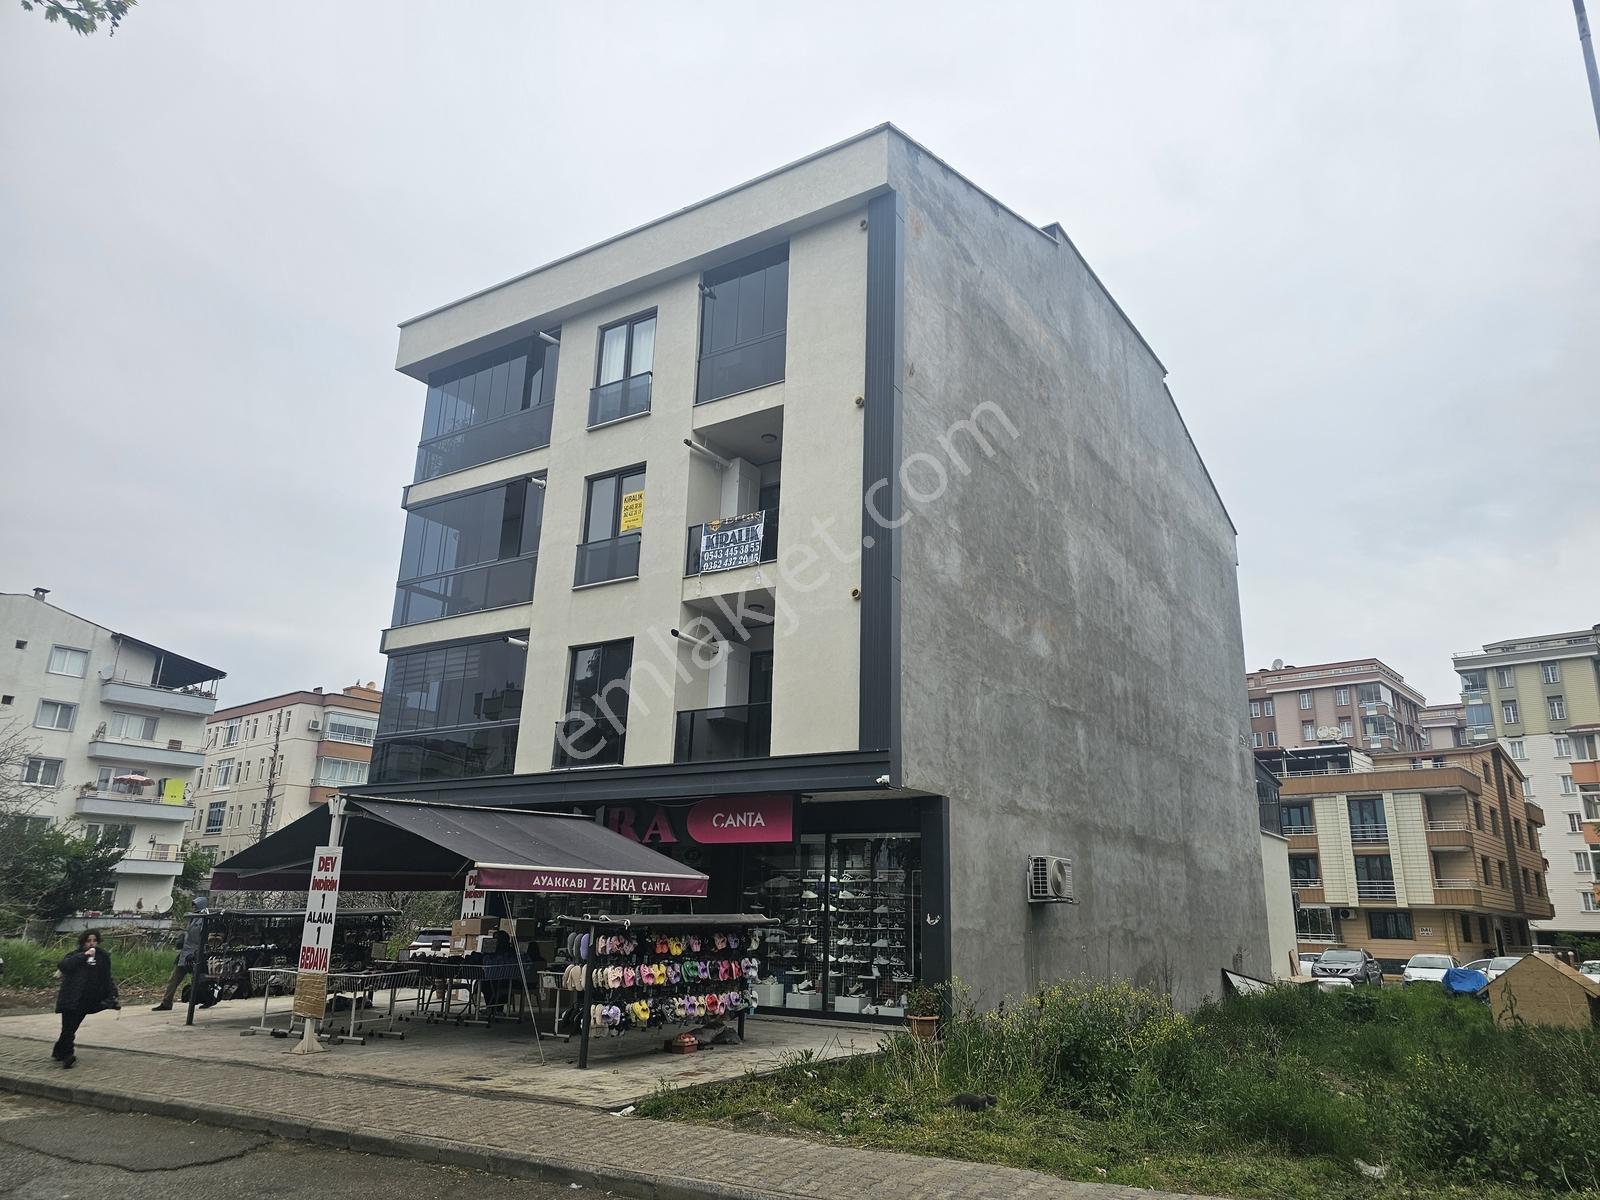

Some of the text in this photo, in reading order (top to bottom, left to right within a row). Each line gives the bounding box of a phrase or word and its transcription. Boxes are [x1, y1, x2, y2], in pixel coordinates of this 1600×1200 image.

[704, 542, 760, 561] 0543 445 38 55
[723, 556, 738, 567] 437
[318, 856, 337, 873] DEV
[312, 876, 338, 891] İNDİRİM
[532, 875, 671, 893] AYAKKABI ZEHRA ÇANTA
[321, 893, 326, 910] 1
[472, 899, 476, 911] 1
[306, 911, 333, 925] ALANA
[316, 926, 321, 945] 1
[300, 946, 329, 971] BEDAVA
